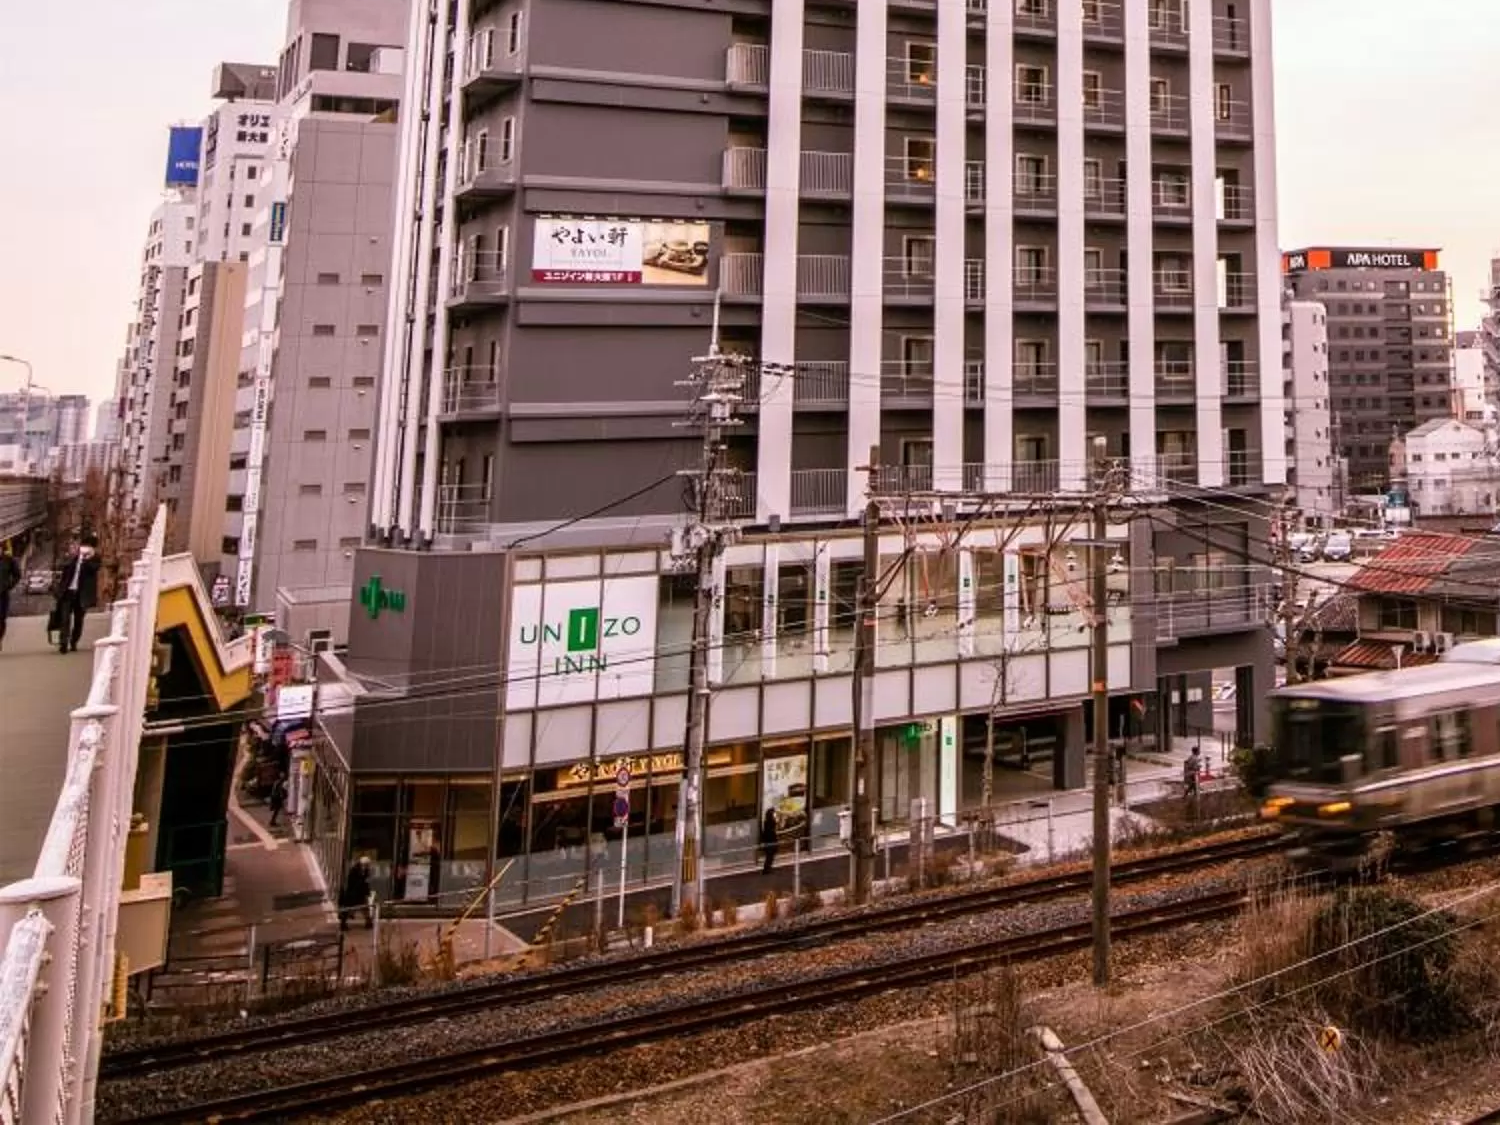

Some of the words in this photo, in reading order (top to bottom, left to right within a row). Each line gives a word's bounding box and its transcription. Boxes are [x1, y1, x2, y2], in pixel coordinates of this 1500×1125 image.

[551, 226, 629, 247] やよい軒
[1347, 253, 1371, 266] APA
[1372, 254, 1411, 266] HOTEL
[520, 607, 641, 652] UNIZO
[555, 654, 607, 676] INN
